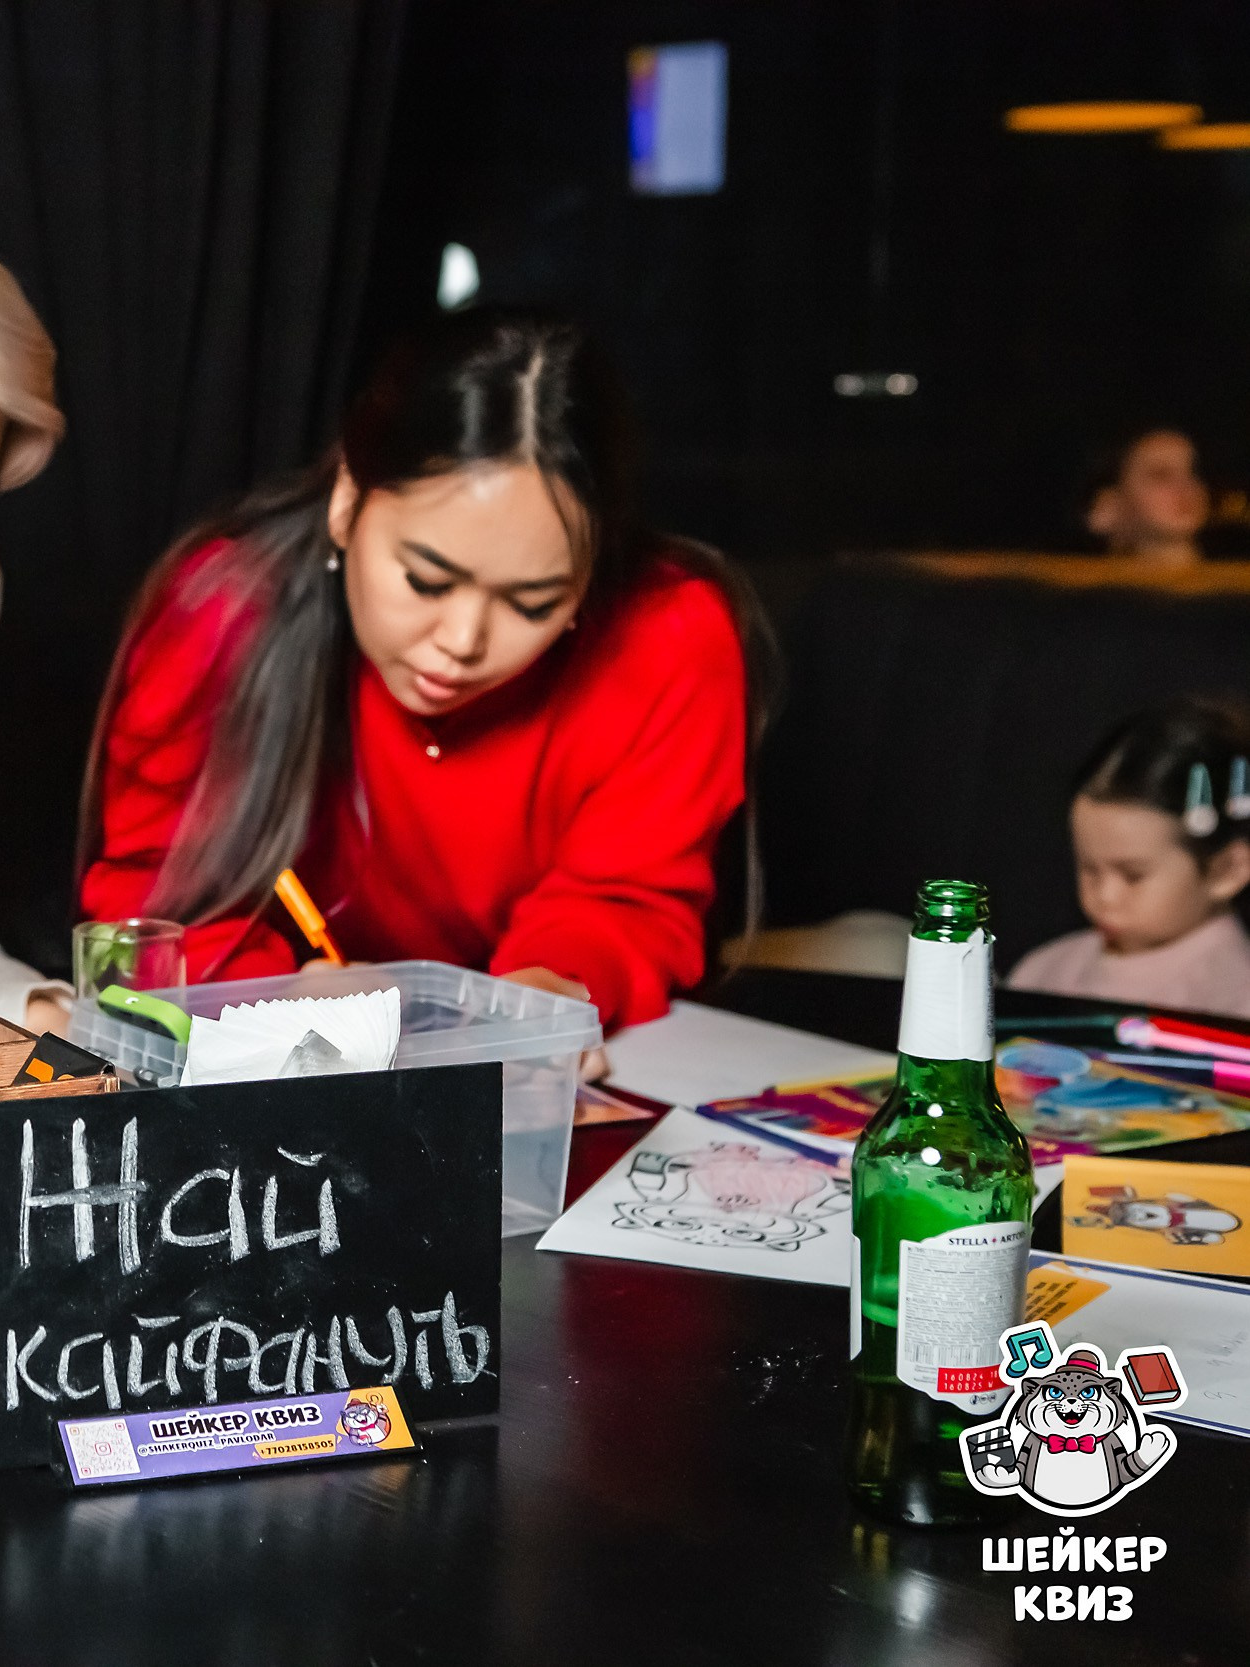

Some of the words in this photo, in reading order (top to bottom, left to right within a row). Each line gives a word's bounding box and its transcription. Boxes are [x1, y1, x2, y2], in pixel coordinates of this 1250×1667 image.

[19, 1115, 341, 1276] Жай
[948, 1237, 988, 1246] STELLA
[944, 1372, 984, 1382] 160824
[943, 1381, 983, 1391] 160825
[152, 1414, 247, 1438] ШЕЙКЕР
[255, 1406, 321, 1429] КВИЗ
